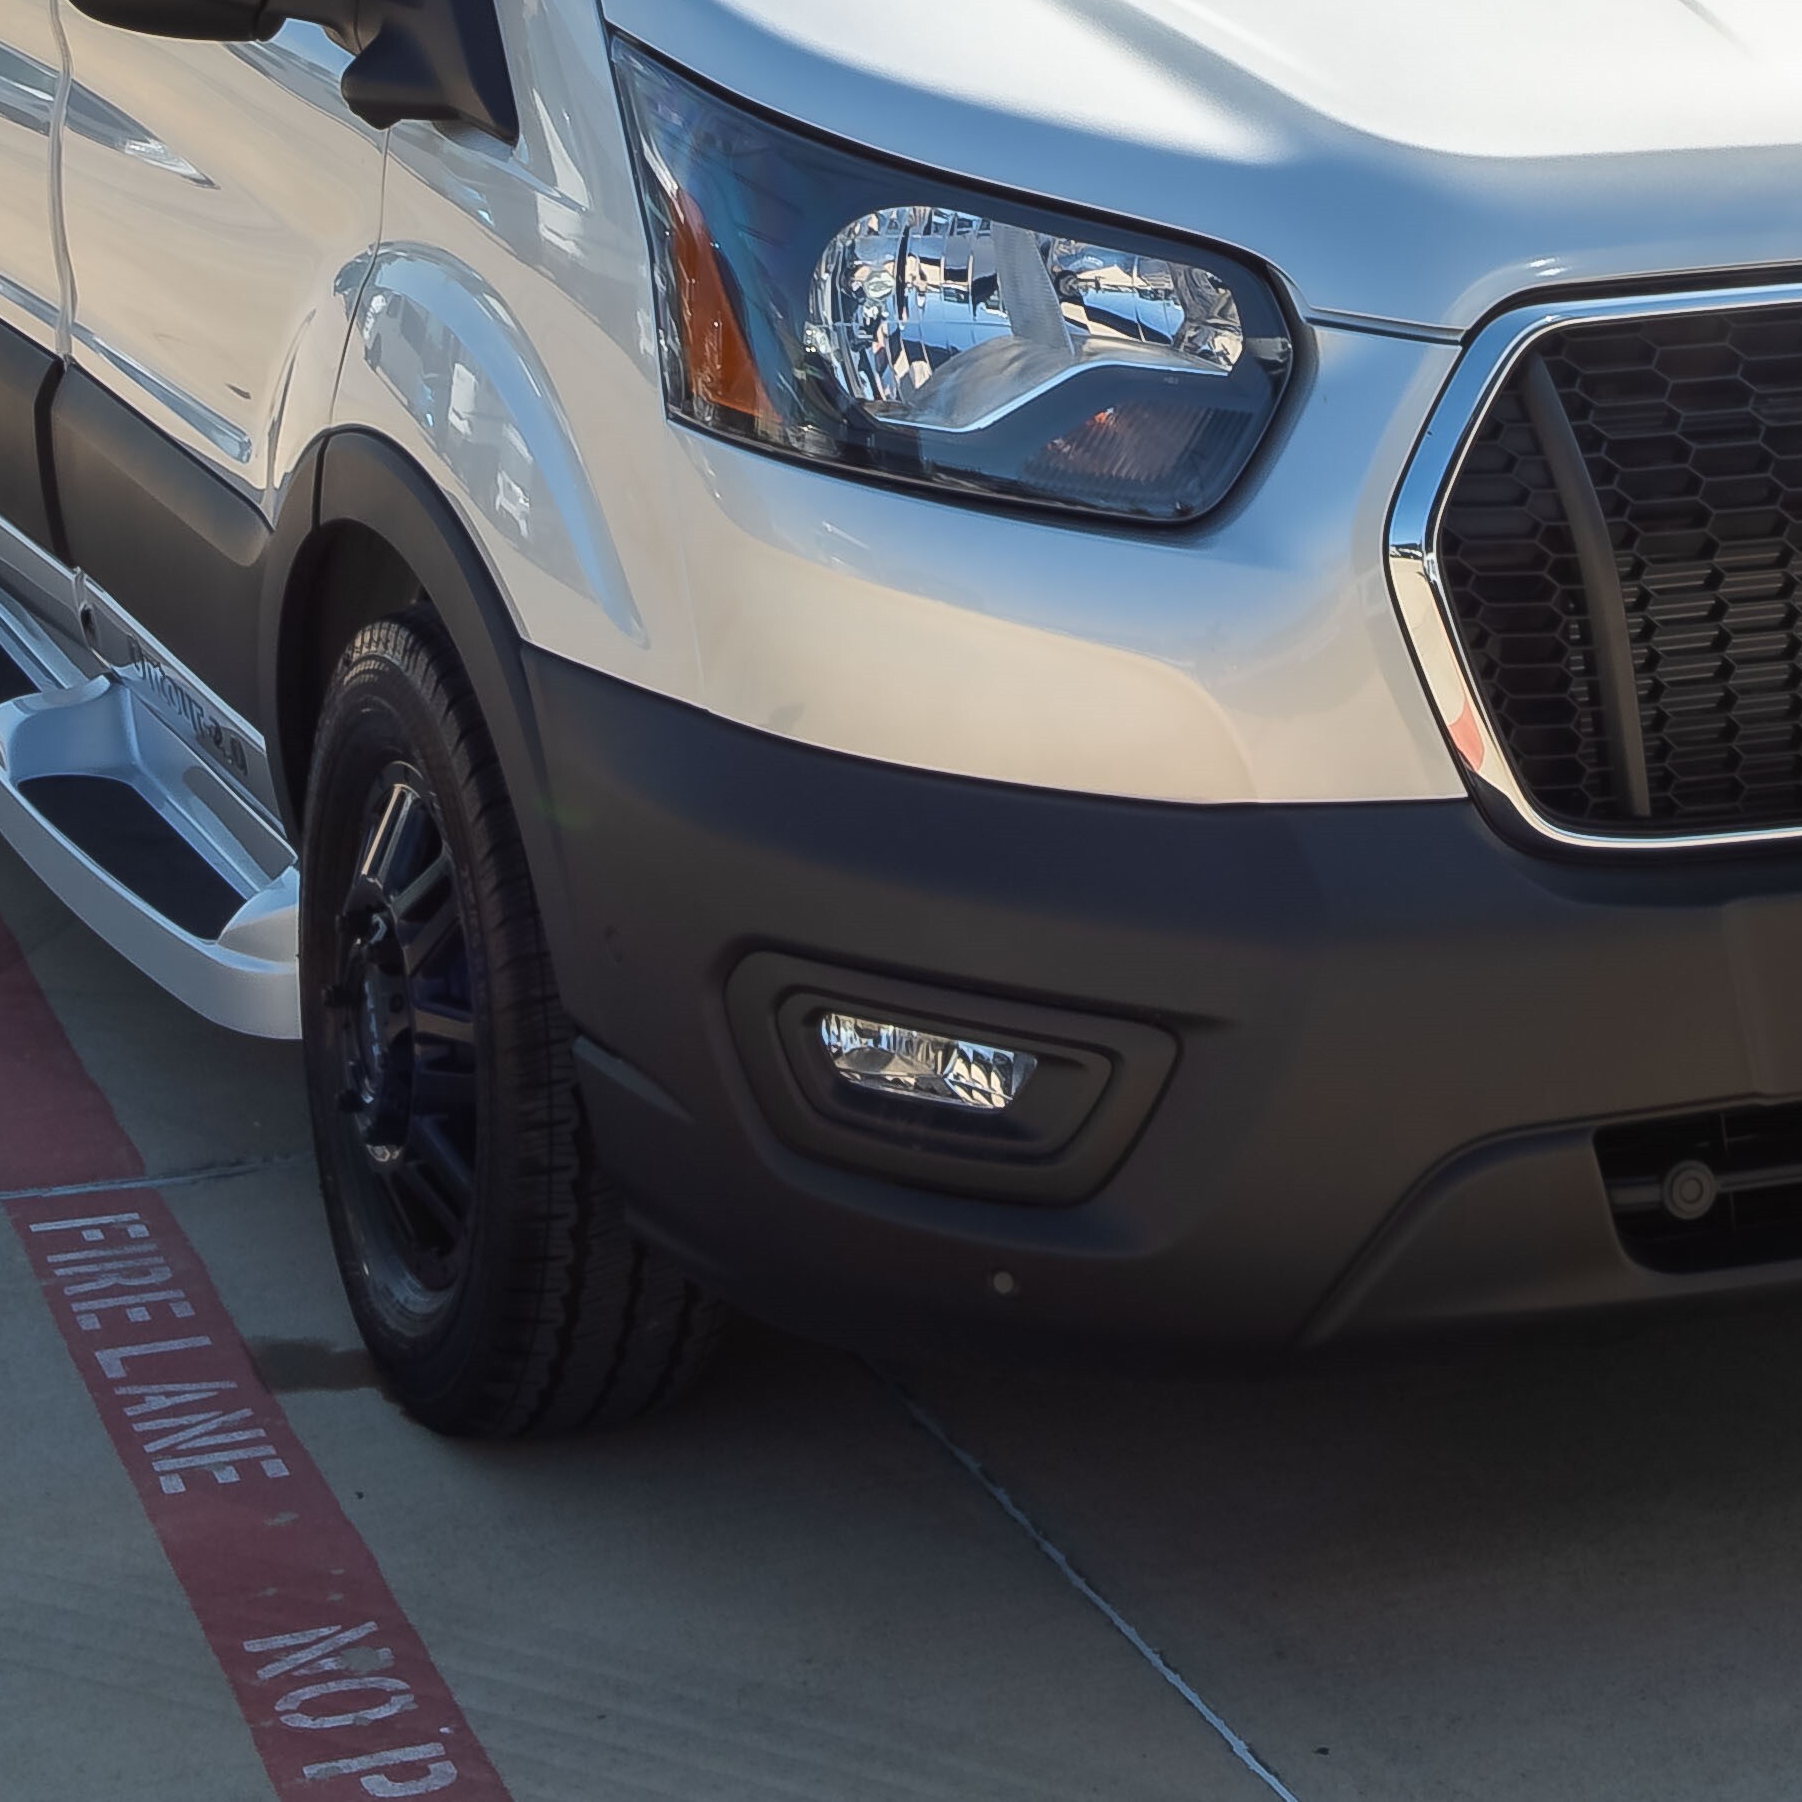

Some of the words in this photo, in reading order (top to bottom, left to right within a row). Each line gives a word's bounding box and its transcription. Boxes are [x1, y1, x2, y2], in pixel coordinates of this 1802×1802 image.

[29, 1211, 196, 1330] FIRE
[94, 1335, 290, 1496] LANE
[243, 1621, 419, 1731] NO
